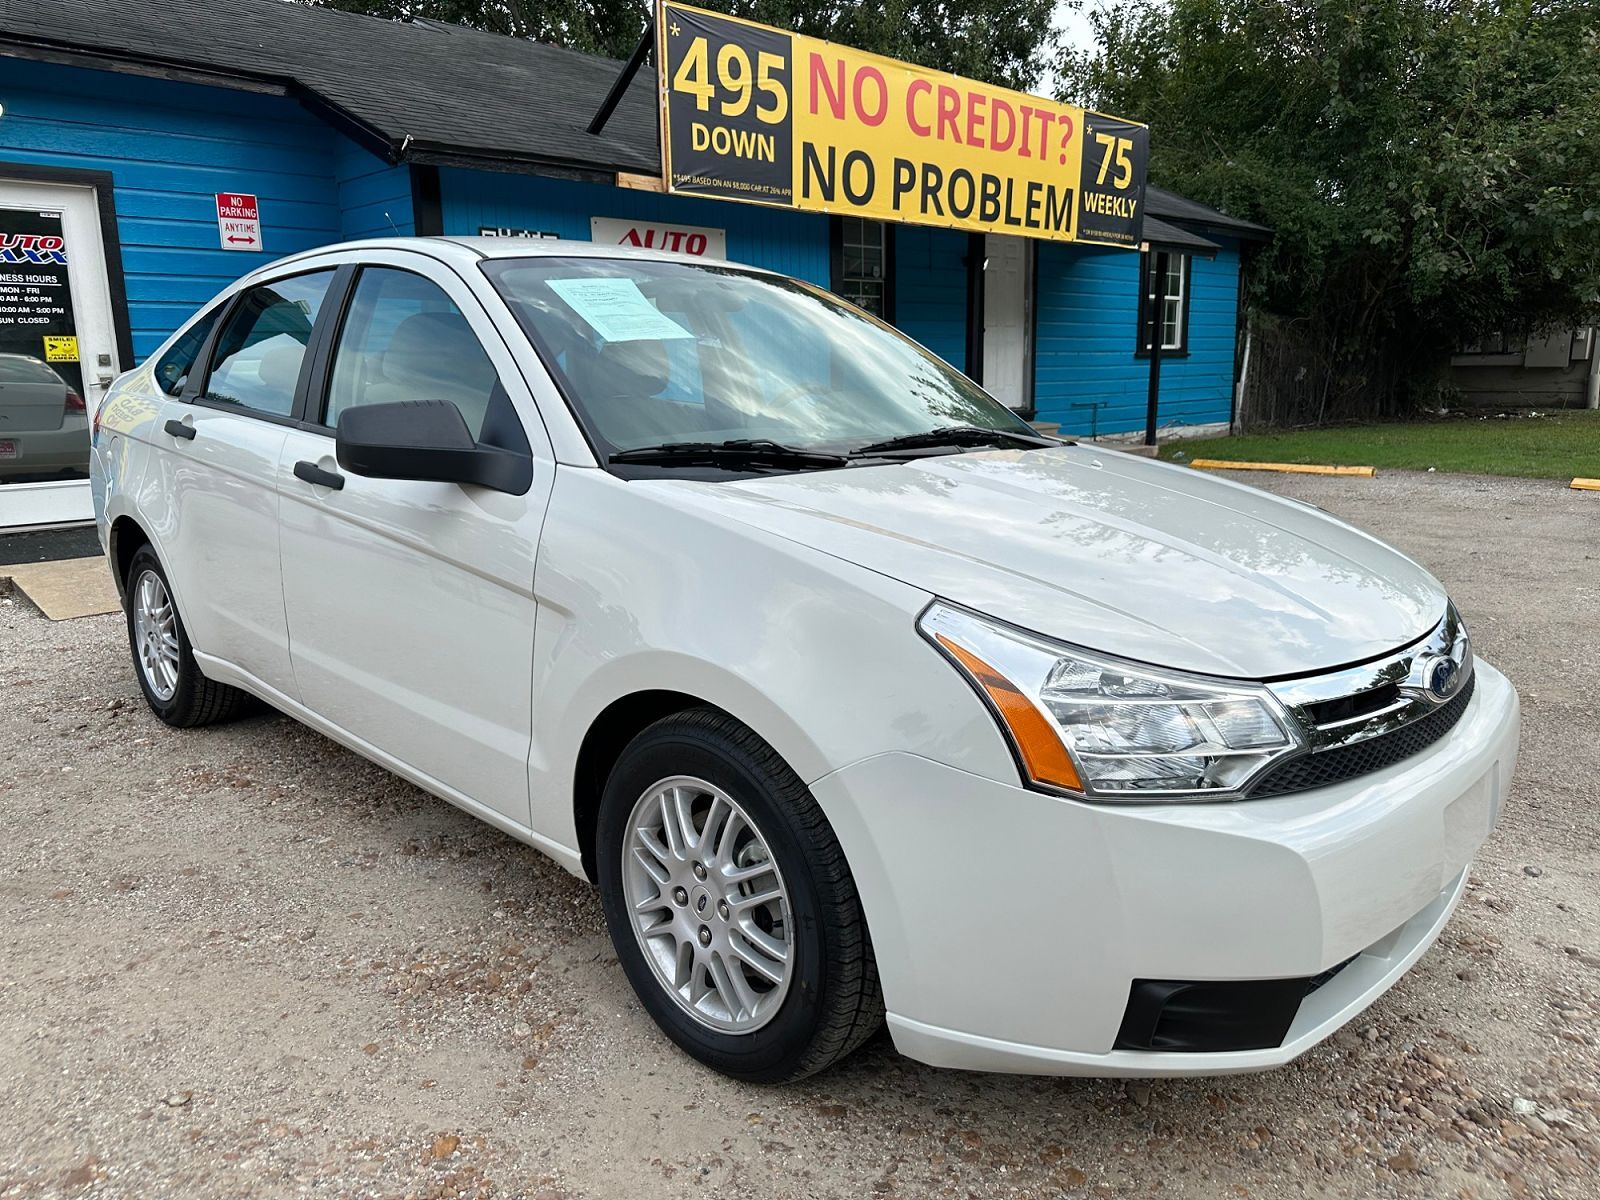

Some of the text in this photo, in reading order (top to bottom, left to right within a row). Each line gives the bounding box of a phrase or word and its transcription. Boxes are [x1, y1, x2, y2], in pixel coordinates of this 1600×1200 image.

[809, 52, 1074, 165] NO CREDIT?
[691, 122, 775, 163] DOWN
[1095, 133, 1133, 190] 75
[692, 176, 711, 186] BASED
[712, 178, 722, 187] ON
[723, 180, 732, 188] AN
[751, 184, 762, 192] CAR
[802, 141, 1074, 233] NO PROBLEM
[220, 206, 257, 218] PARKING
[230, 196, 243, 207] NO
[1084, 191, 1137, 219] WEEKLY
[225, 222, 256, 233] ANYTIME
[618, 228, 707, 256] AUTO
[25, 275, 58, 283] HOURS
